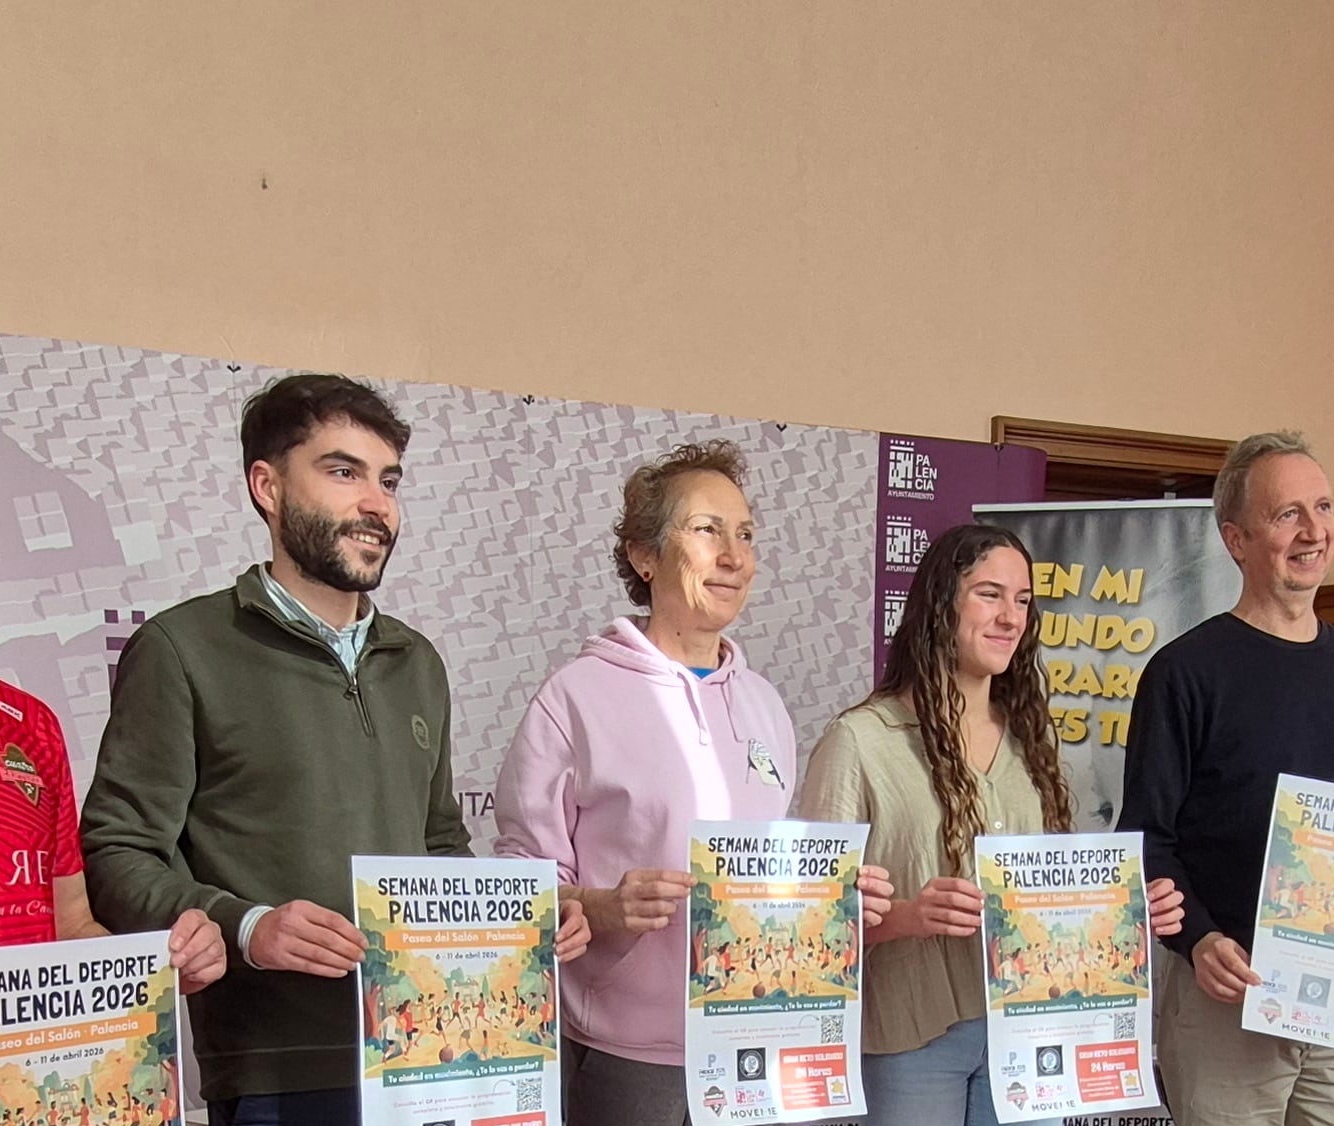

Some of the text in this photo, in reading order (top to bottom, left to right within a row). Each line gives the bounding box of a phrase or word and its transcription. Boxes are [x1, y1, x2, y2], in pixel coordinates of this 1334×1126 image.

[916, 455, 930, 466] PA
[916, 468, 937, 479] LEN
[915, 479, 934, 490] CIA
[888, 490, 934, 500] AYUNTAMIENTO
[914, 529, 928, 540] PA
[1032, 562, 1144, 604] EN MI
[1039, 610, 1154, 653] UNDO
[708, 838, 848, 854] SEMANA DEL DEPORTE
[716, 857, 839, 876] PALENCIA 2026
[995, 849, 1126, 867] SEMANA DEL DEPORTE
[1003, 867, 1121, 888] PALENCIA 2026
[378, 878, 539, 896] SEMANA DEL DEPORTE
[10, 904, 21, 914] la
[389, 900, 533, 924] PALENCIA 2026
[402, 931, 526, 943] Paseo del Salón Palencia
[39, 964, 73, 988] DEL
[80, 955, 157, 983] DEPORTE
[92, 982, 149, 1013] 2026
[26, 1031, 44, 1045] del
[49, 1028, 81, 1042] Salón
[91, 1020, 138, 1036] Palencia
[40, 1056, 47, 1064] 11
[51, 1054, 60, 1062] de
[63, 1050, 82, 1060] abril
[84, 1048, 103, 1057] 2026
